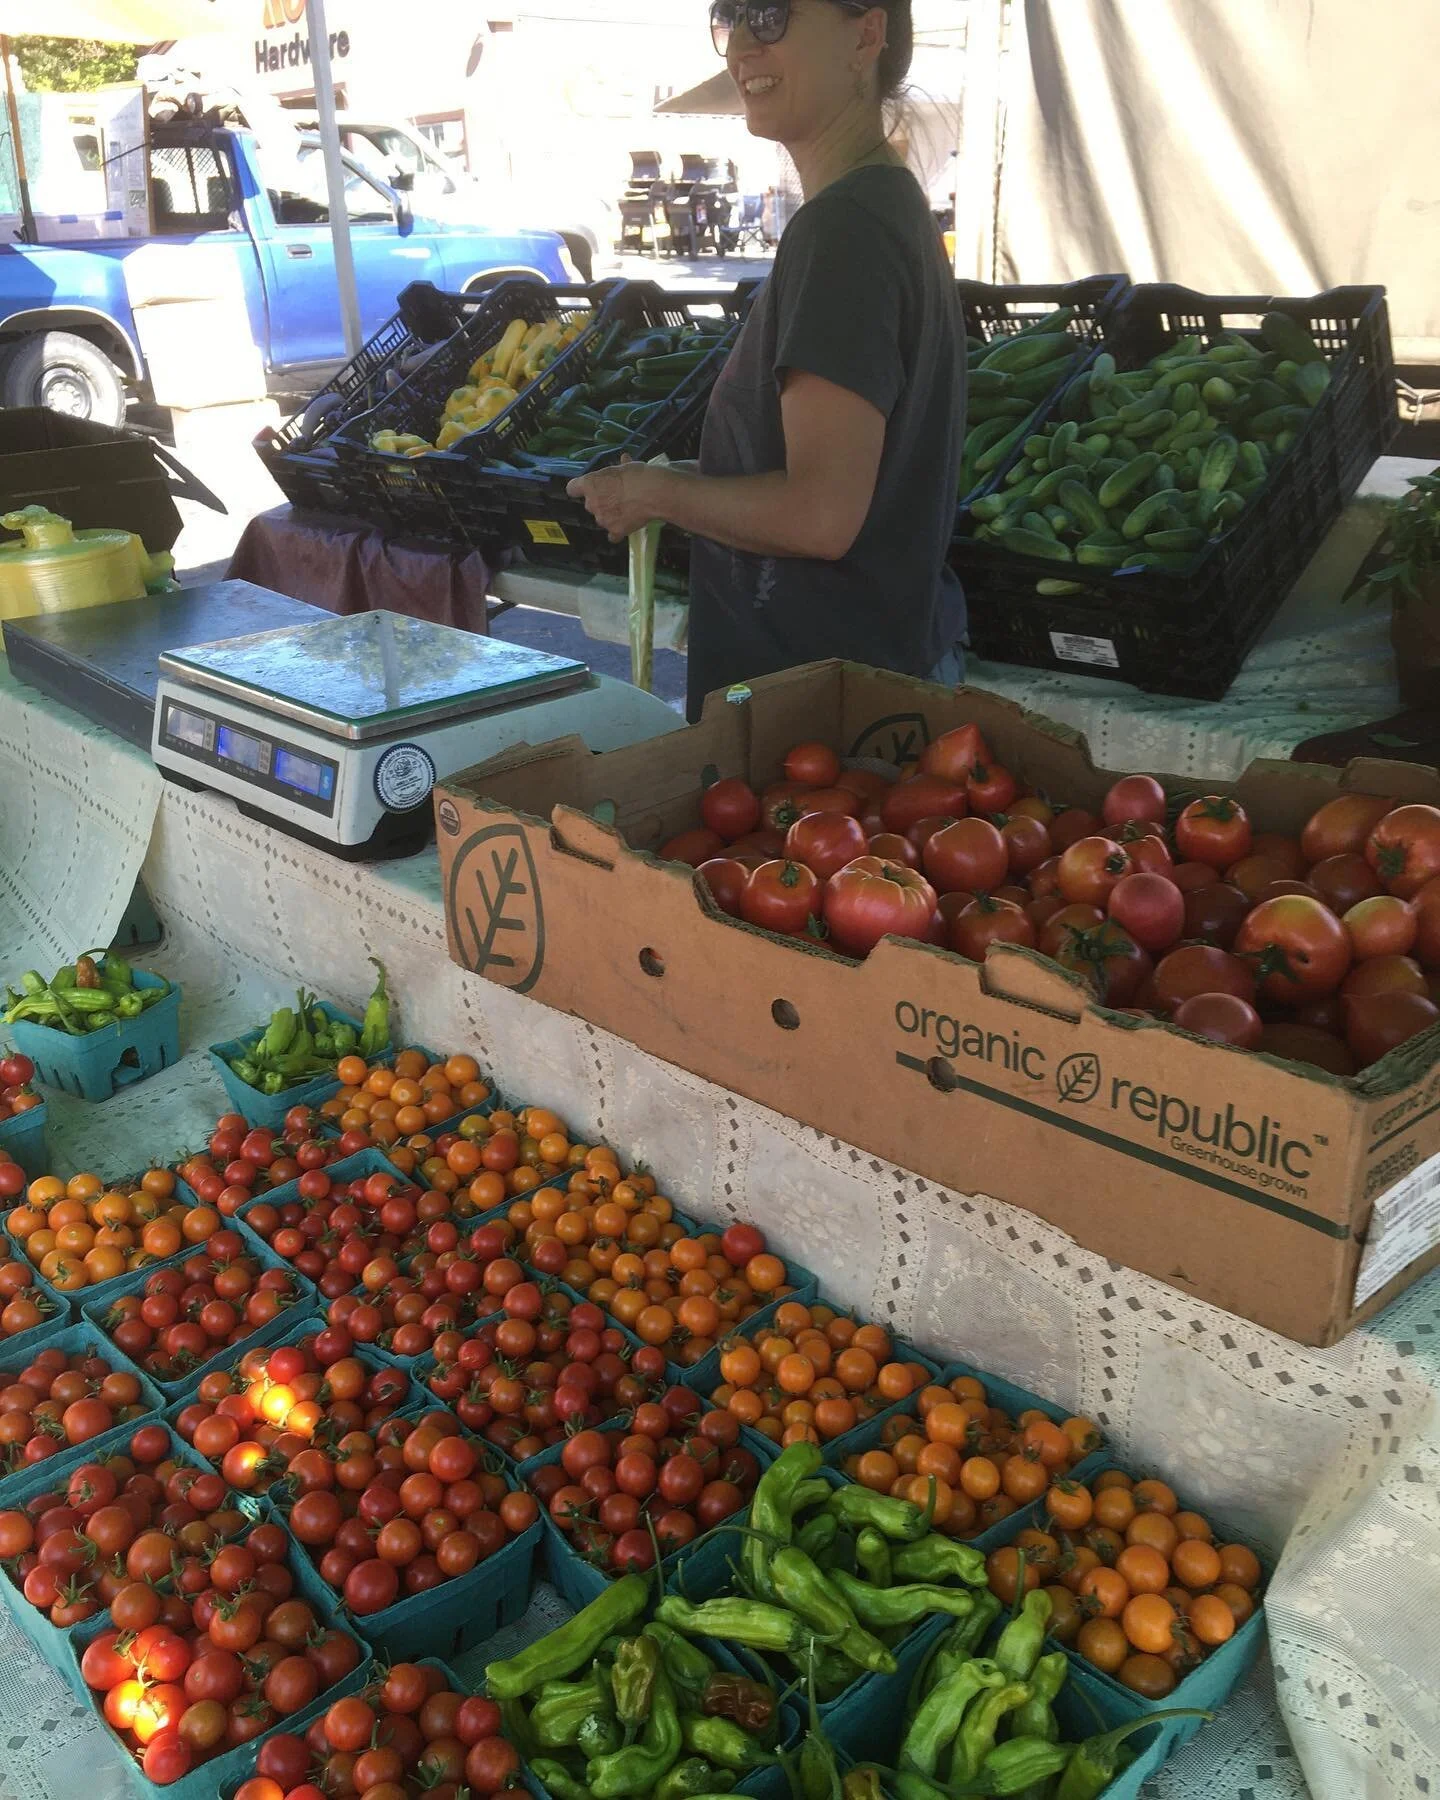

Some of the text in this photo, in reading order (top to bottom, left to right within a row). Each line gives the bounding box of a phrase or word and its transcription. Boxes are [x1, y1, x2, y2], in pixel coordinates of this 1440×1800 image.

[255, 30, 350, 73] Hardwre
[895, 1000, 1046, 1081] organic
[1111, 1077, 1313, 1179] republic
[1170, 1135, 1309, 1200] Greenhouse grown
